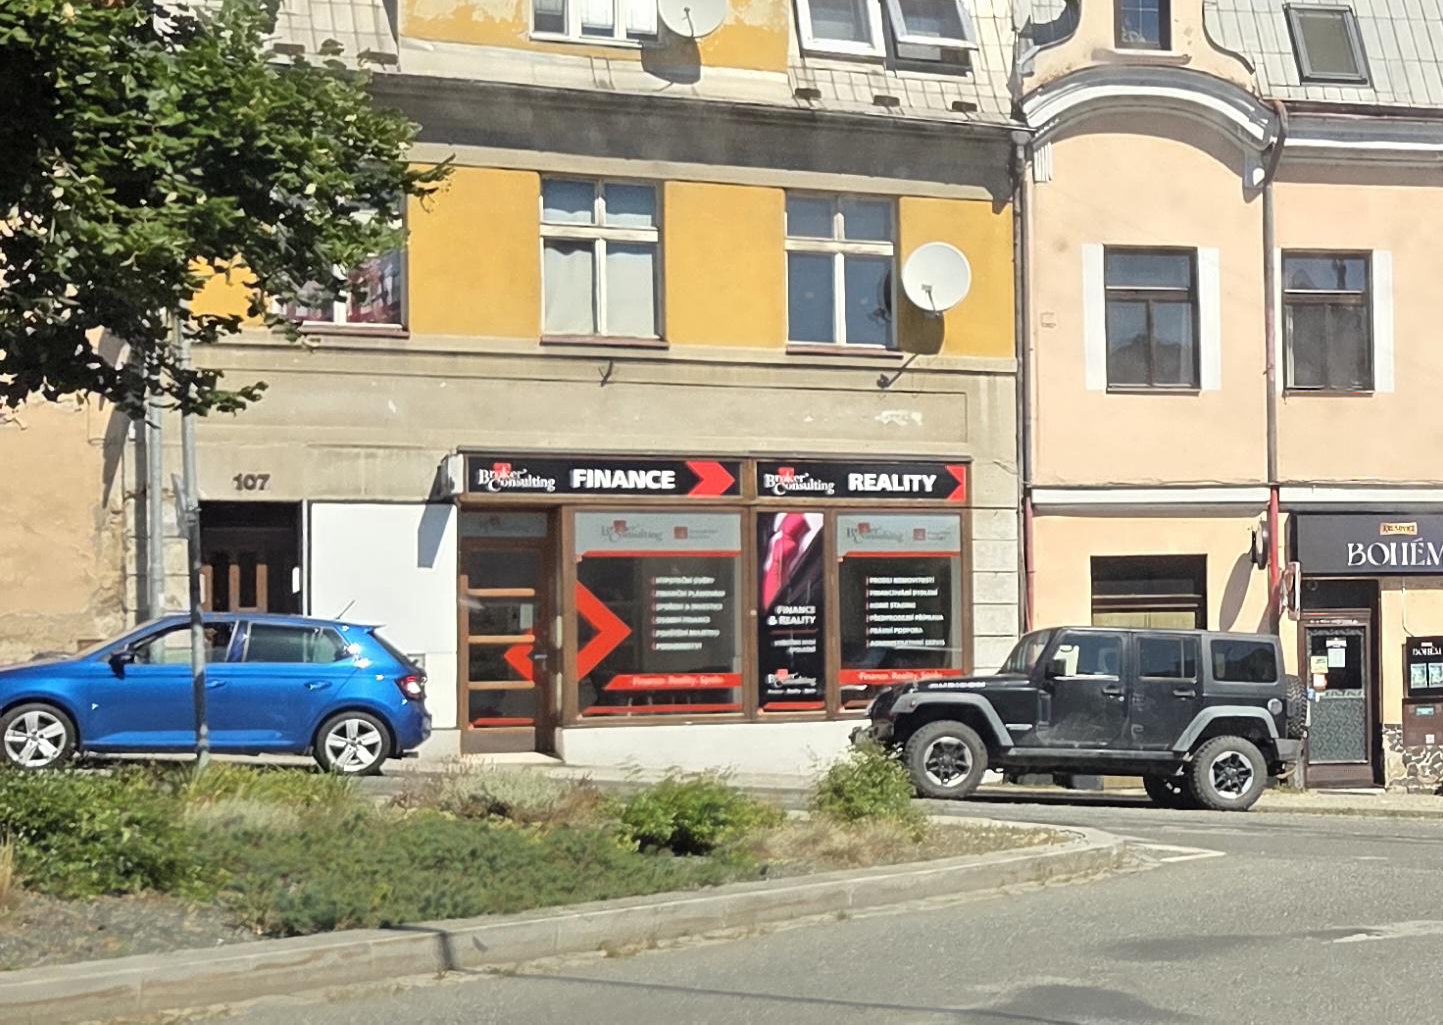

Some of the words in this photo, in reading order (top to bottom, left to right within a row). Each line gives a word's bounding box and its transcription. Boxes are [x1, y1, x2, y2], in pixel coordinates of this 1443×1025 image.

[233, 473, 270, 491] 107
[487, 474, 556, 492] Consulting
[572, 469, 676, 490] FINANCE
[773, 479, 835, 495] Consulting
[848, 473, 937, 492] REALITY
[775, 605, 816, 615] FINANCE
[767, 615, 777, 626] &
[779, 615, 816, 626] REALITY
